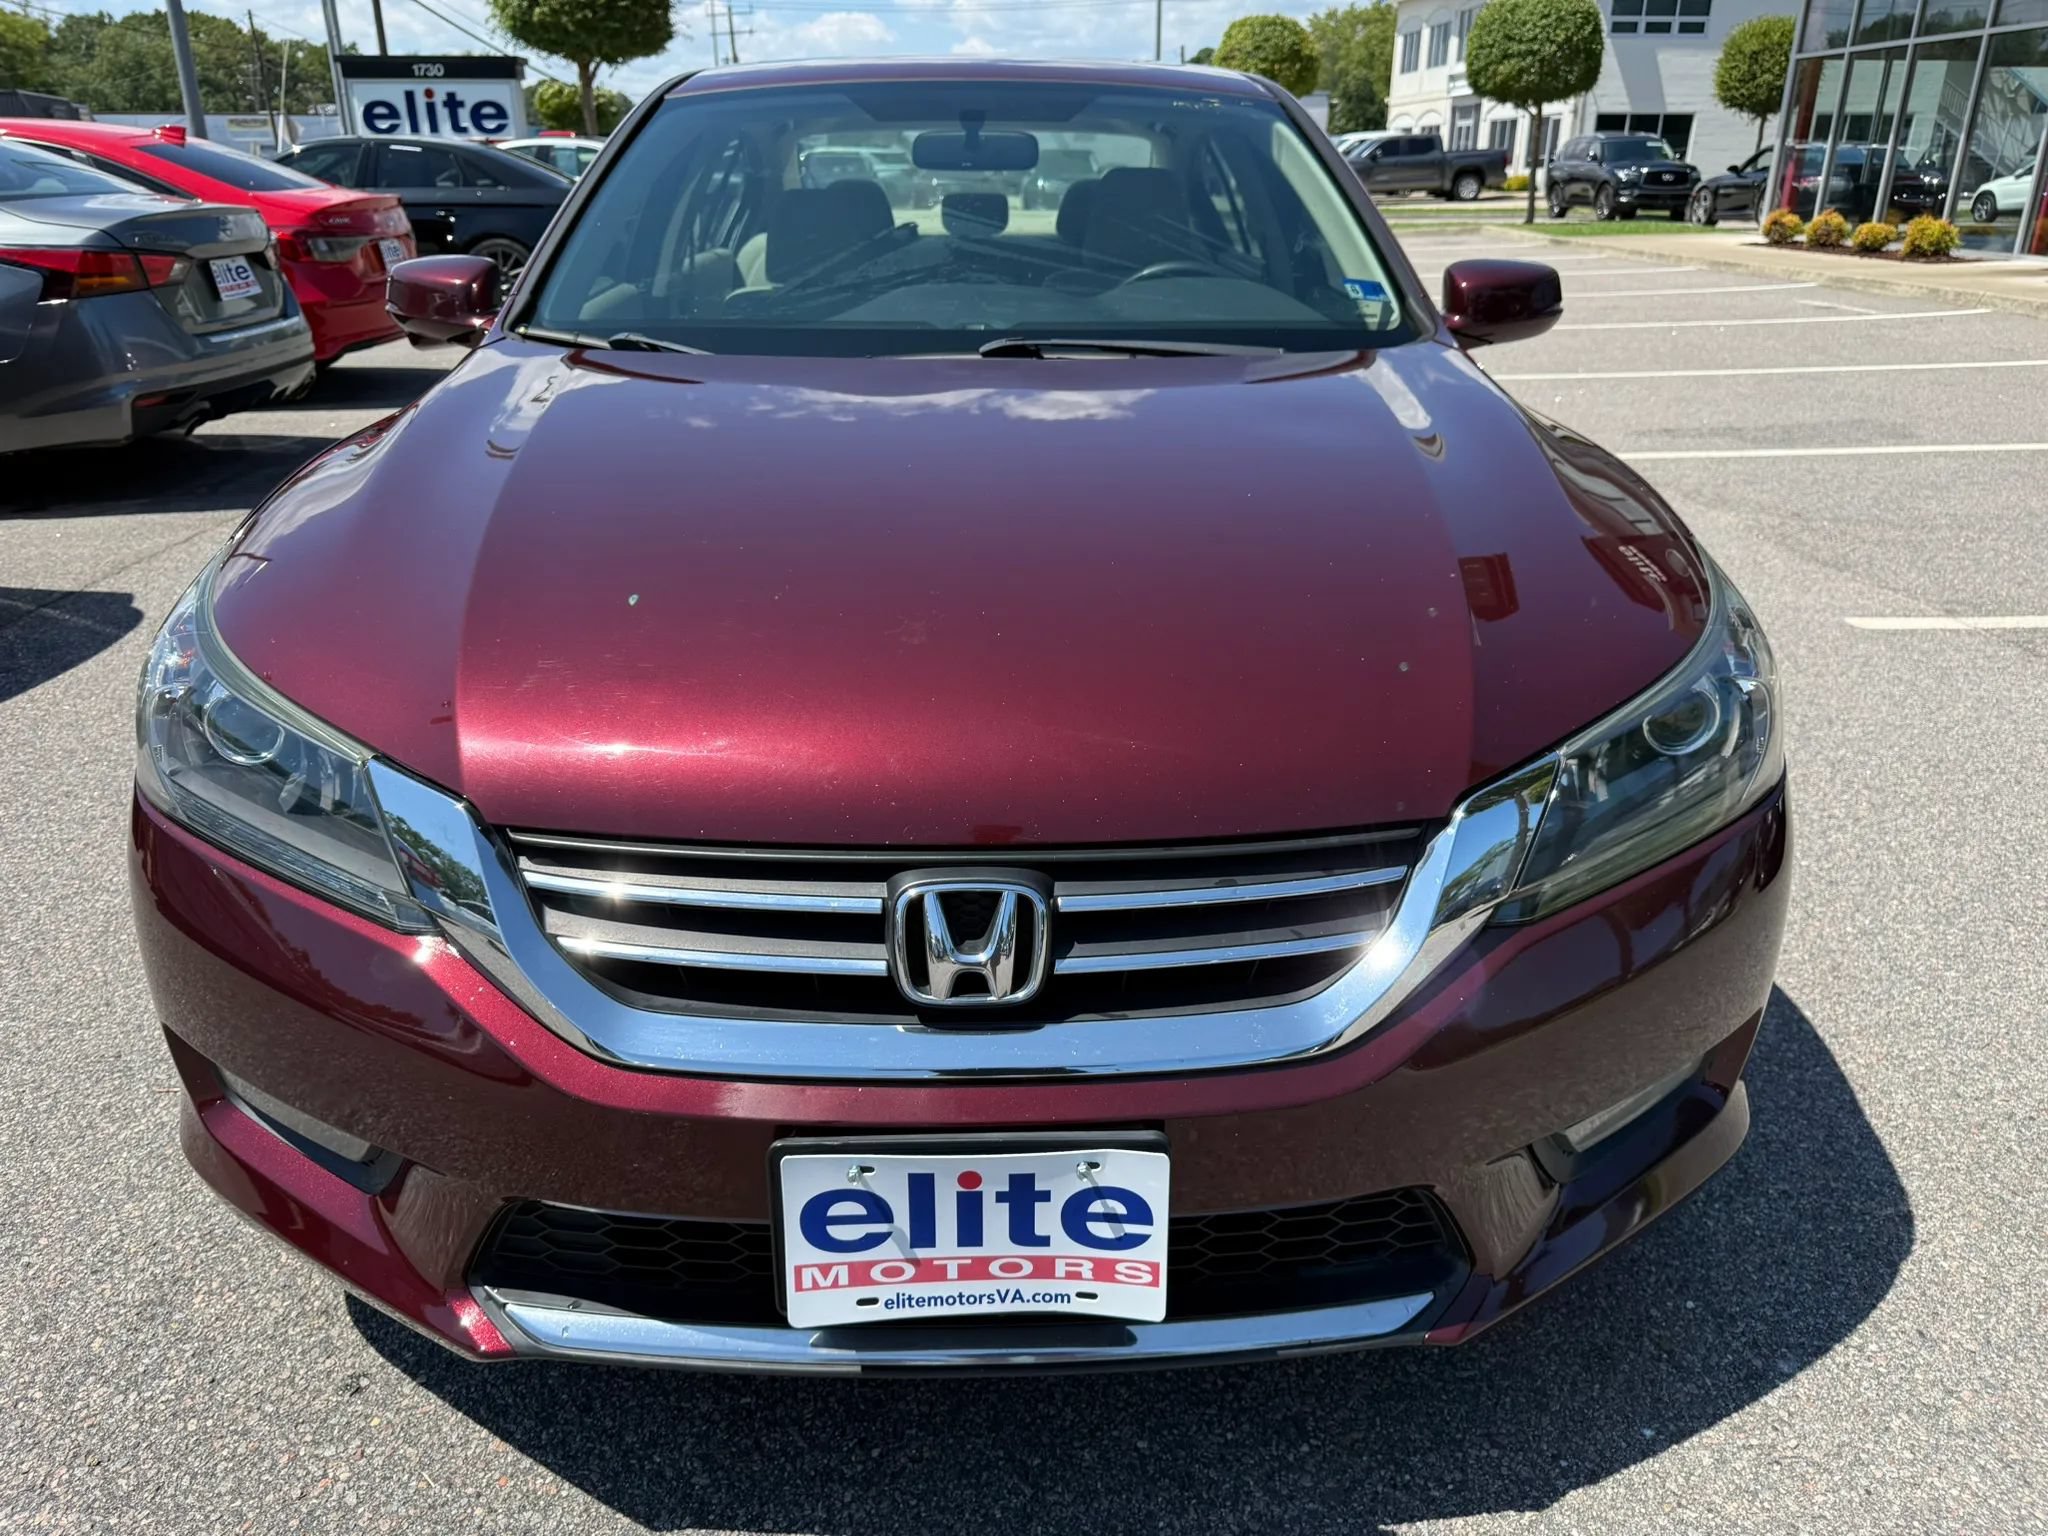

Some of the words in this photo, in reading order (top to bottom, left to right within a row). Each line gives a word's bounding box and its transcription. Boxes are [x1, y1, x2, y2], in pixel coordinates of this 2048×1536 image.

[411, 63, 445, 77] 1730
[362, 87, 510, 135] elite
[799, 1170, 1155, 1254] elite
[801, 1257, 1154, 1290] MOTORS
[883, 1287, 1072, 1310] elitemotorsVA.com
